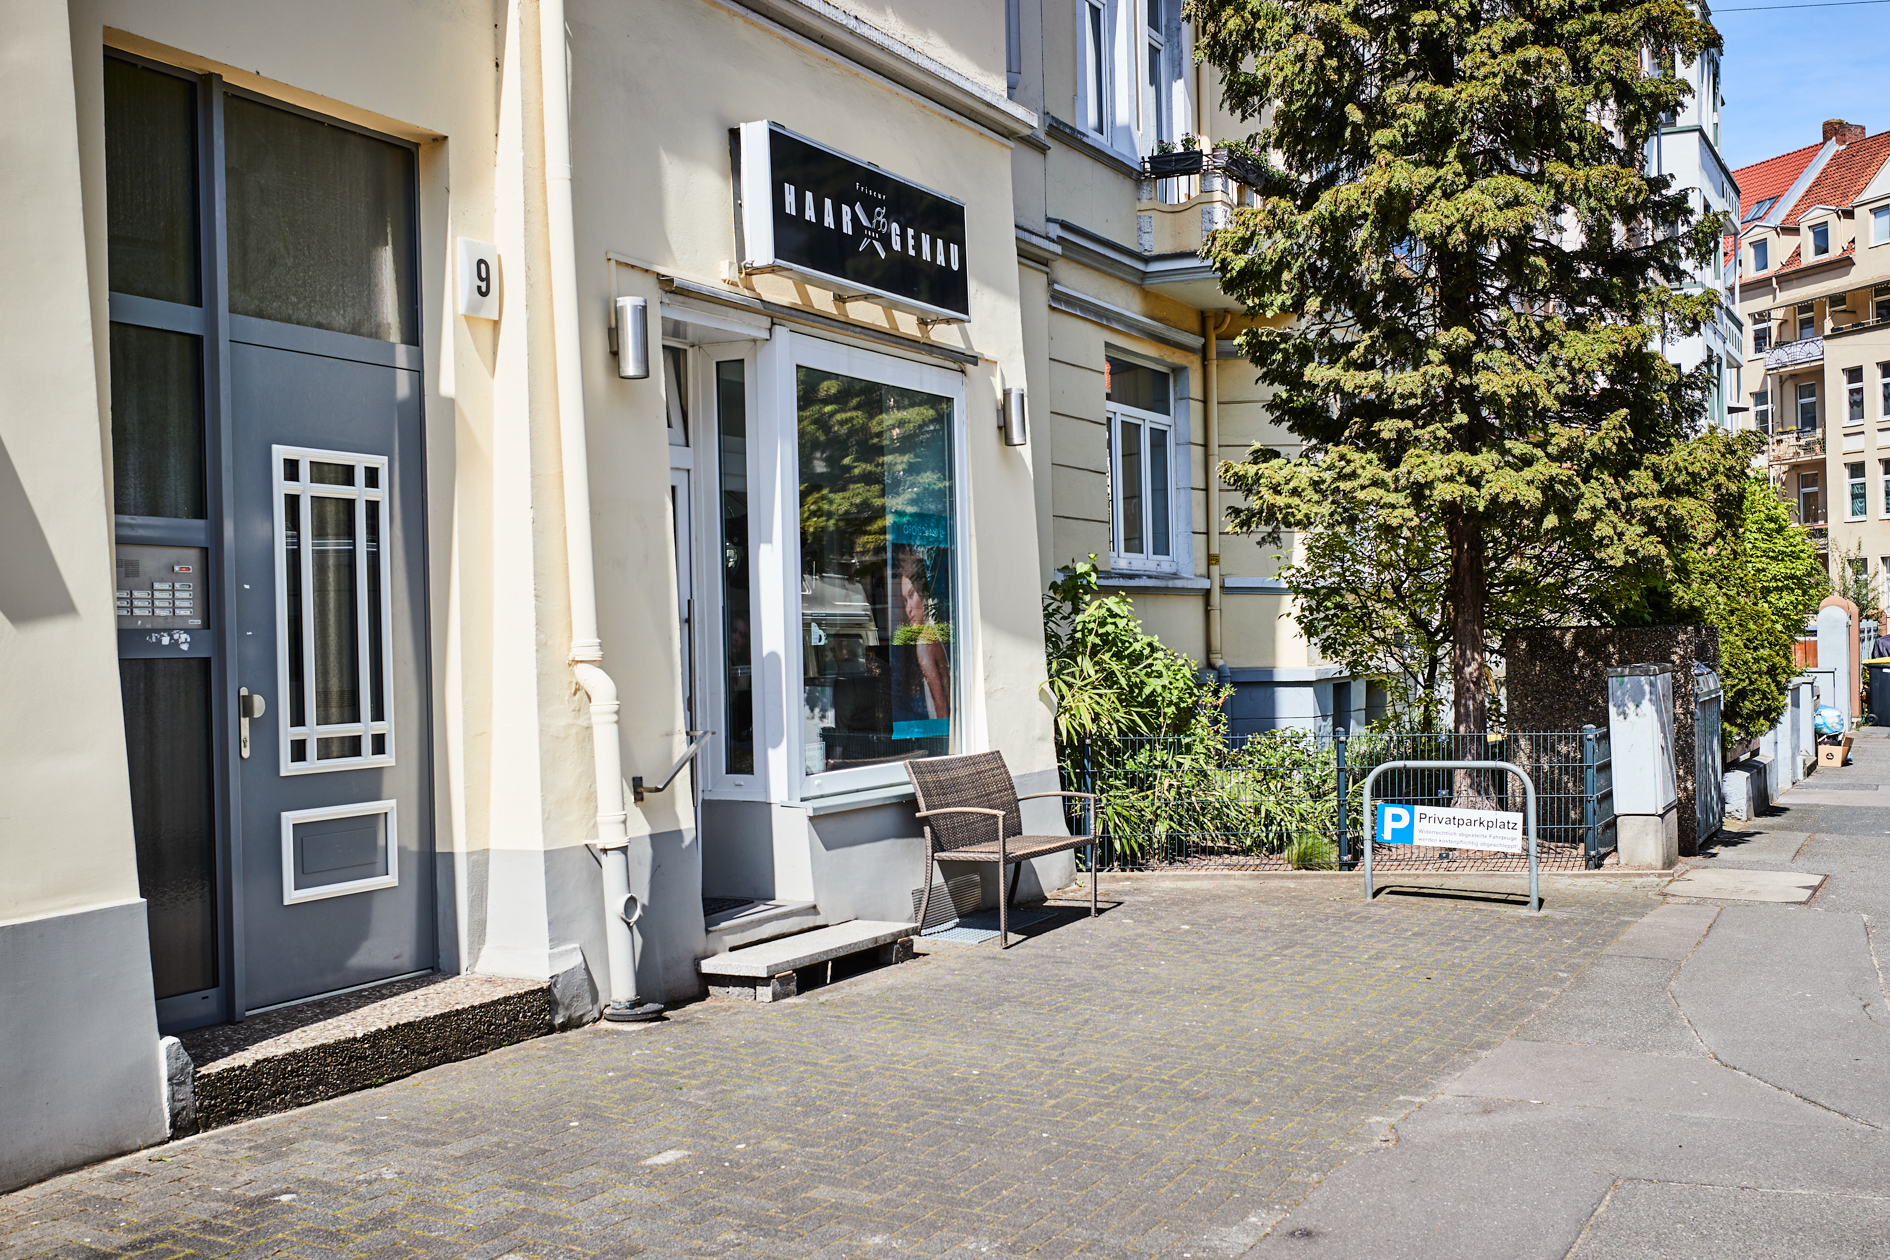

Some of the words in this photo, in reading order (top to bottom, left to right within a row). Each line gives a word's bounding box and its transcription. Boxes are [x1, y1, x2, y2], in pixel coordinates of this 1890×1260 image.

[856, 182, 886, 201] Friseur
[784, 183, 853, 235] HAAR
[890, 221, 959, 271] GENAU
[476, 258, 491, 298] 9
[1383, 806, 1410, 841] P
[1419, 812, 1518, 830] Privatparkplatz
[1418, 829, 1458, 837] Widerrechtlich
[1488, 833, 1518, 842] Fahrzeuge
[1439, 839, 1479, 847] kostenpflichtig
